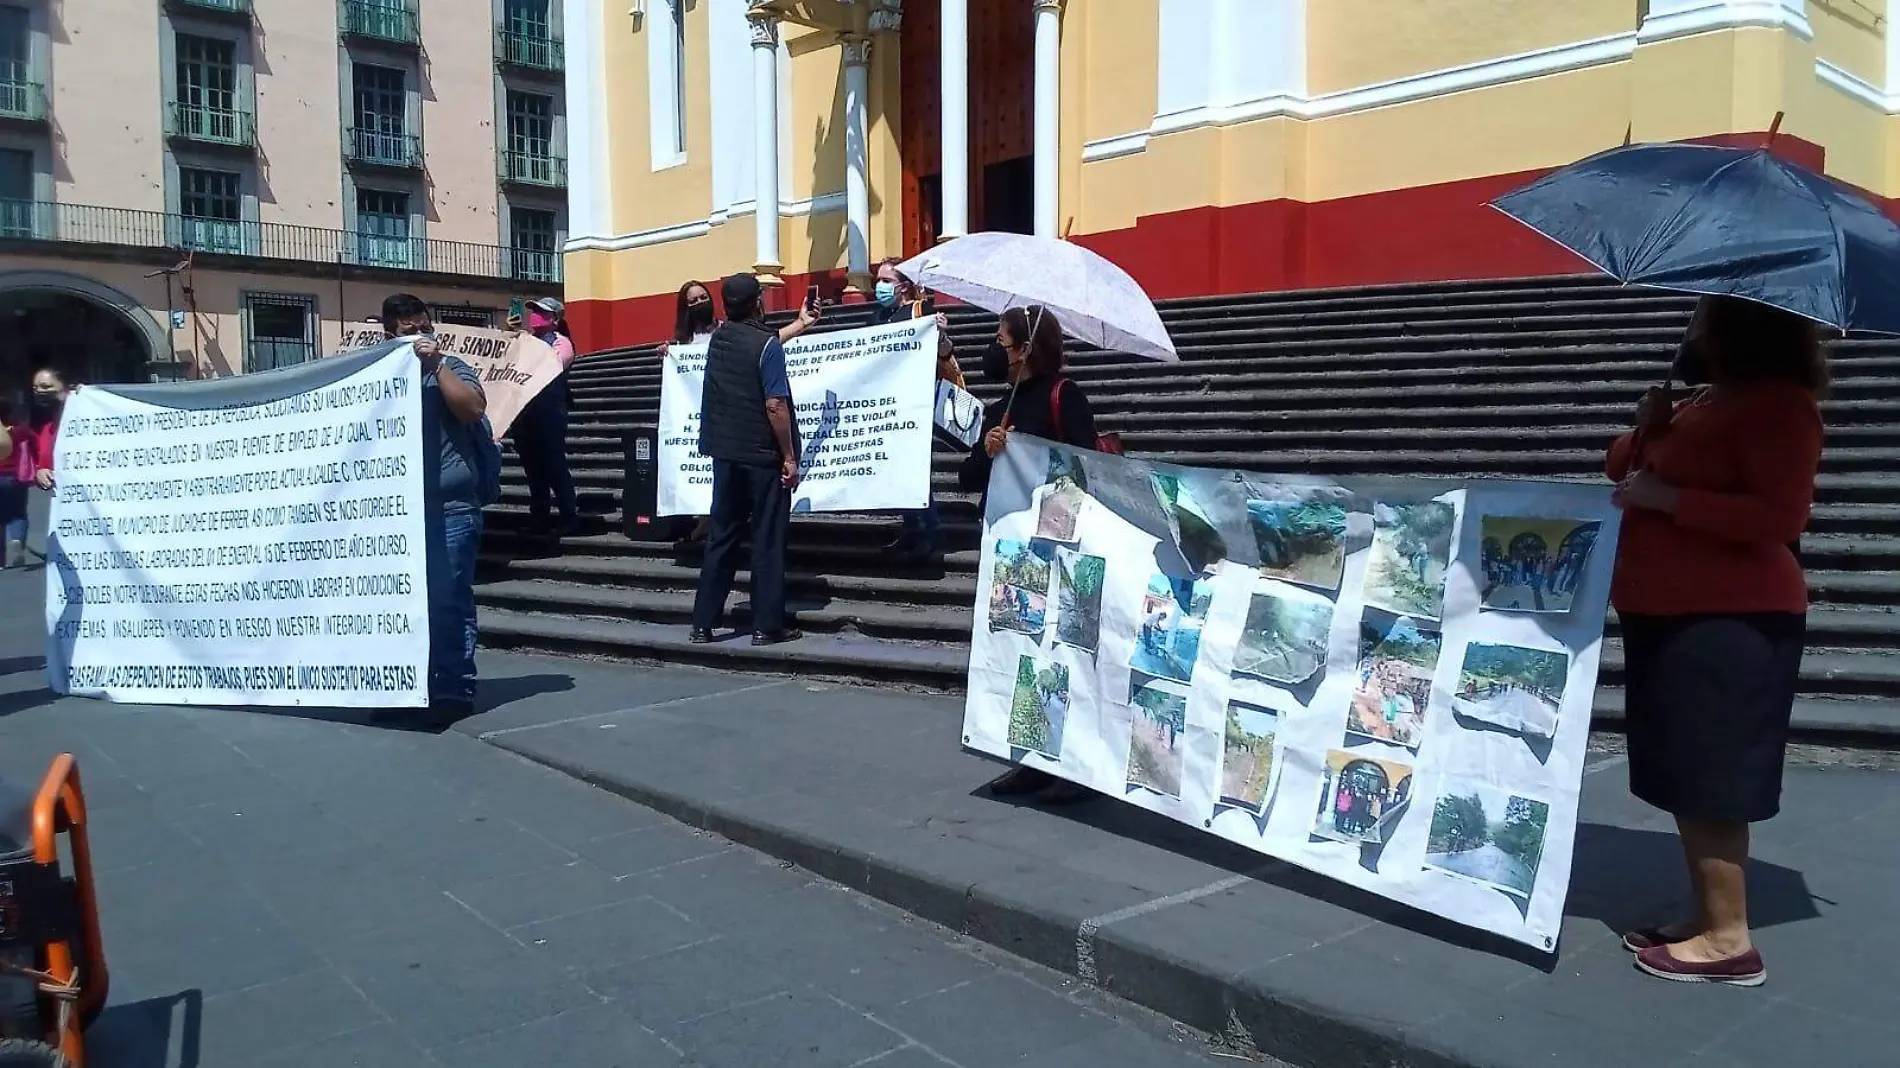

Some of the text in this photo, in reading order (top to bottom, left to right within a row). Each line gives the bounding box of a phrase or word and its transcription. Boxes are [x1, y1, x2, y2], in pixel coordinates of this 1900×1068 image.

[679, 328, 916, 361] SINDIC RABAJADORES AL SERVICIO
[811, 355, 822, 364] DE
[826, 350, 862, 362] FERRER
[313, 389, 323, 413] SU
[384, 379, 392, 400] A
[794, 398, 876, 413] NDICALIZADOS
[879, 396, 897, 406] DEL
[824, 415, 840, 425] NO
[844, 414, 859, 424] SE
[862, 409, 897, 422] VIOLEN
[191, 442, 201, 462] EN
[274, 432, 285, 453] DE
[288, 428, 318, 451] EMPLEO
[321, 426, 332, 447] DE
[334, 424, 344, 445] LA
[347, 421, 373, 443] CUAL
[799, 429, 849, 440] NERALES
[852, 427, 865, 437] DE
[868, 421, 919, 434] TRABAJO.
[805, 444, 830, 454] CON
[833, 437, 884, 452] NUESTRAS
[680, 451, 889, 472] OBLIG CUAL PEDIMOS EL
[801, 471, 837, 482] ESTROS
[208, 510, 219, 531] DE
[324, 500, 338, 522] SE
[340, 499, 357, 521] NOS
[396, 494, 408, 516] EL
[275, 541, 287, 563] DE
[289, 538, 332, 562] FEBRERO
[334, 537, 348, 560] DEL
[366, 536, 377, 557] EN
[241, 580, 261, 601] NOS
[262, 578, 305, 600] HICIERON
[357, 572, 412, 597] CONDICIONES
[219, 617, 233, 638] EN
[235, 616, 273, 638] RIESGO
[276, 615, 321, 637] NUESTRA
[323, 614, 374, 636] INTEGRIDAD
[165, 665, 177, 689] DE
[178, 665, 203, 689] ESTOS
[245, 665, 267, 690] PUES
[268, 665, 286, 690] SON
[287, 665, 297, 690] EL
[360, 665, 383, 691] PARA
